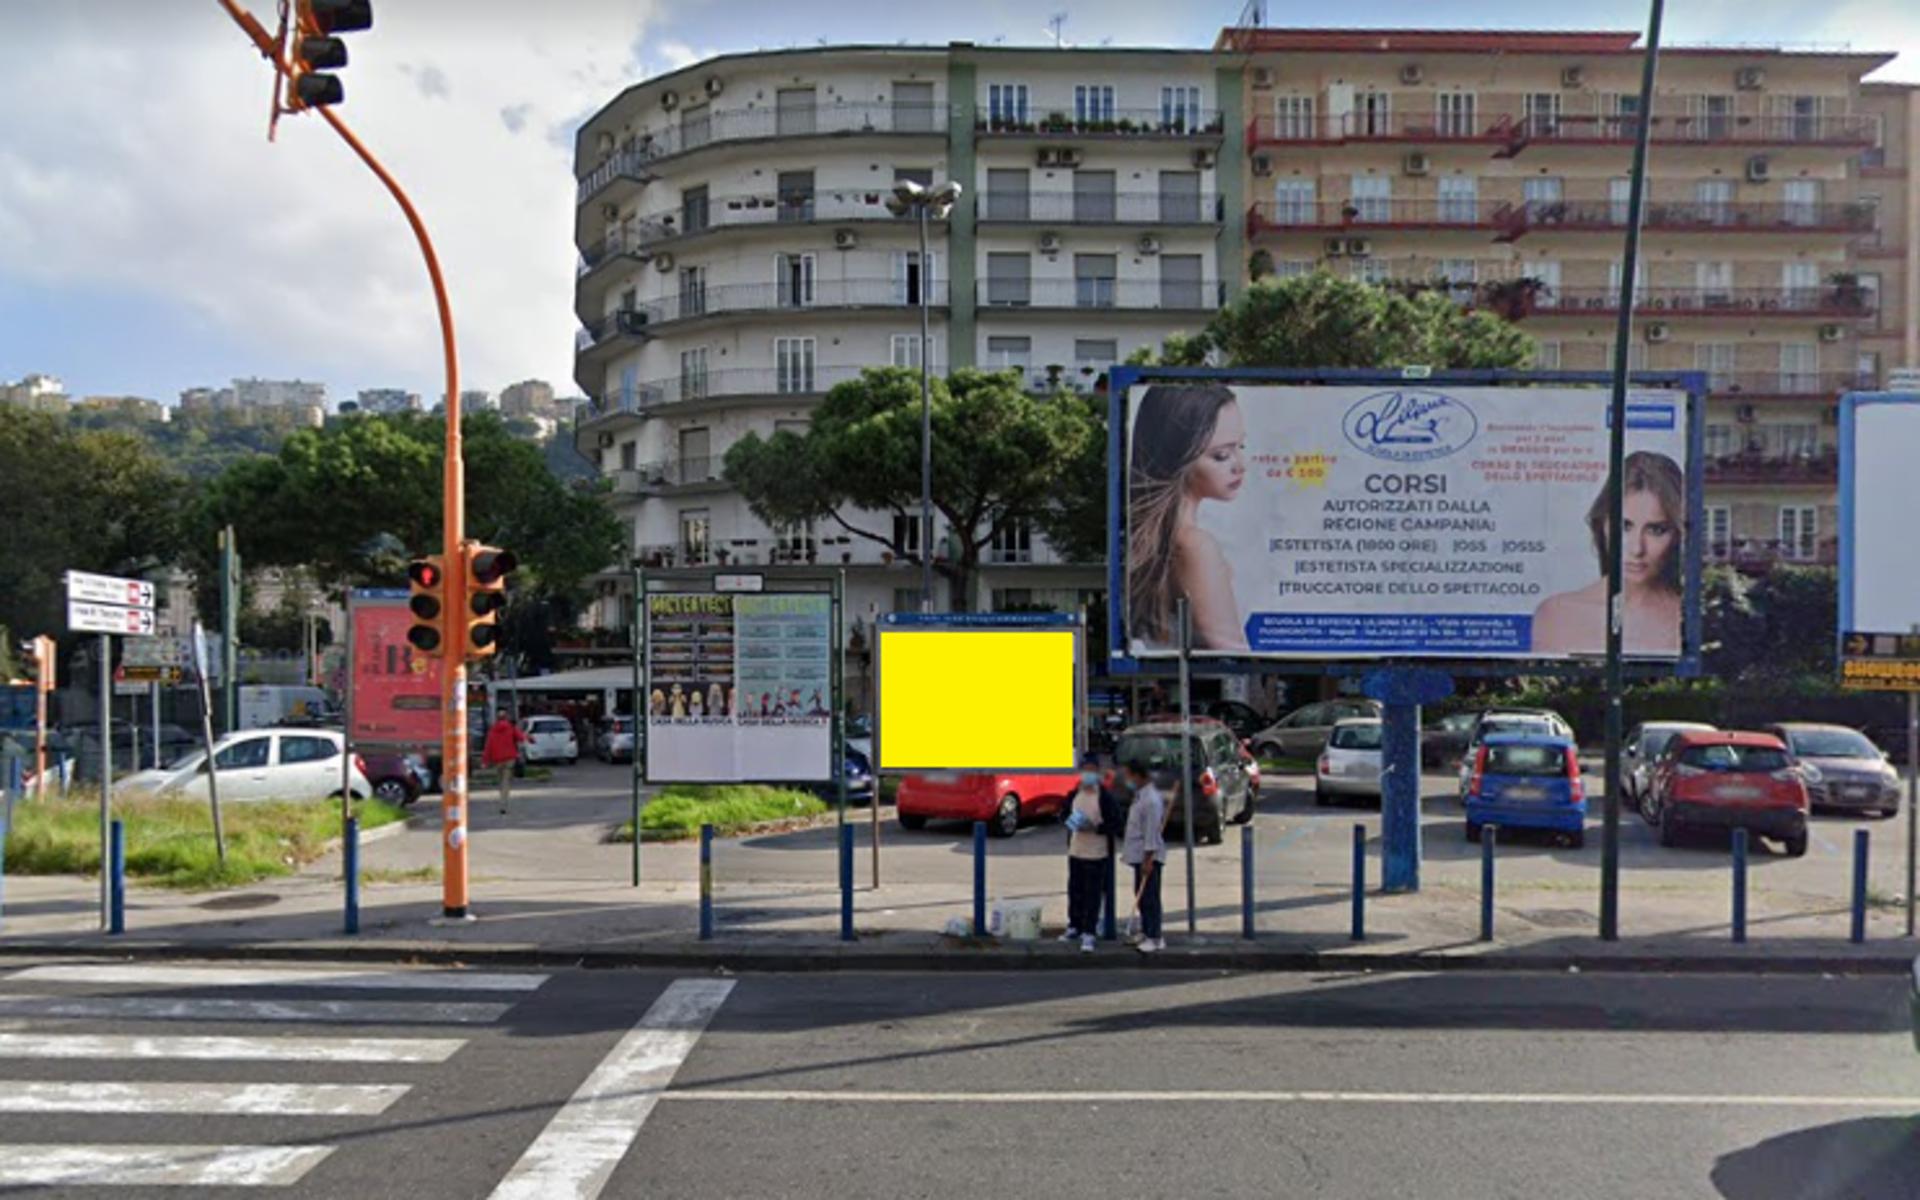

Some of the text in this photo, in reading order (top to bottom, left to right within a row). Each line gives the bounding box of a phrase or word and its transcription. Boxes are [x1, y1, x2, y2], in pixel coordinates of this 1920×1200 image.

[1364, 473, 1447, 494] CORSI
[1323, 500, 1492, 513] AUTORIZZATI DALLA
[1323, 518, 1397, 531] REGIONE
[1381, 560, 1525, 574] SPECIALIZZAZIONE
[1388, 582, 1440, 595] DELLO
[1442, 582, 1541, 596] SPETTACOLO
